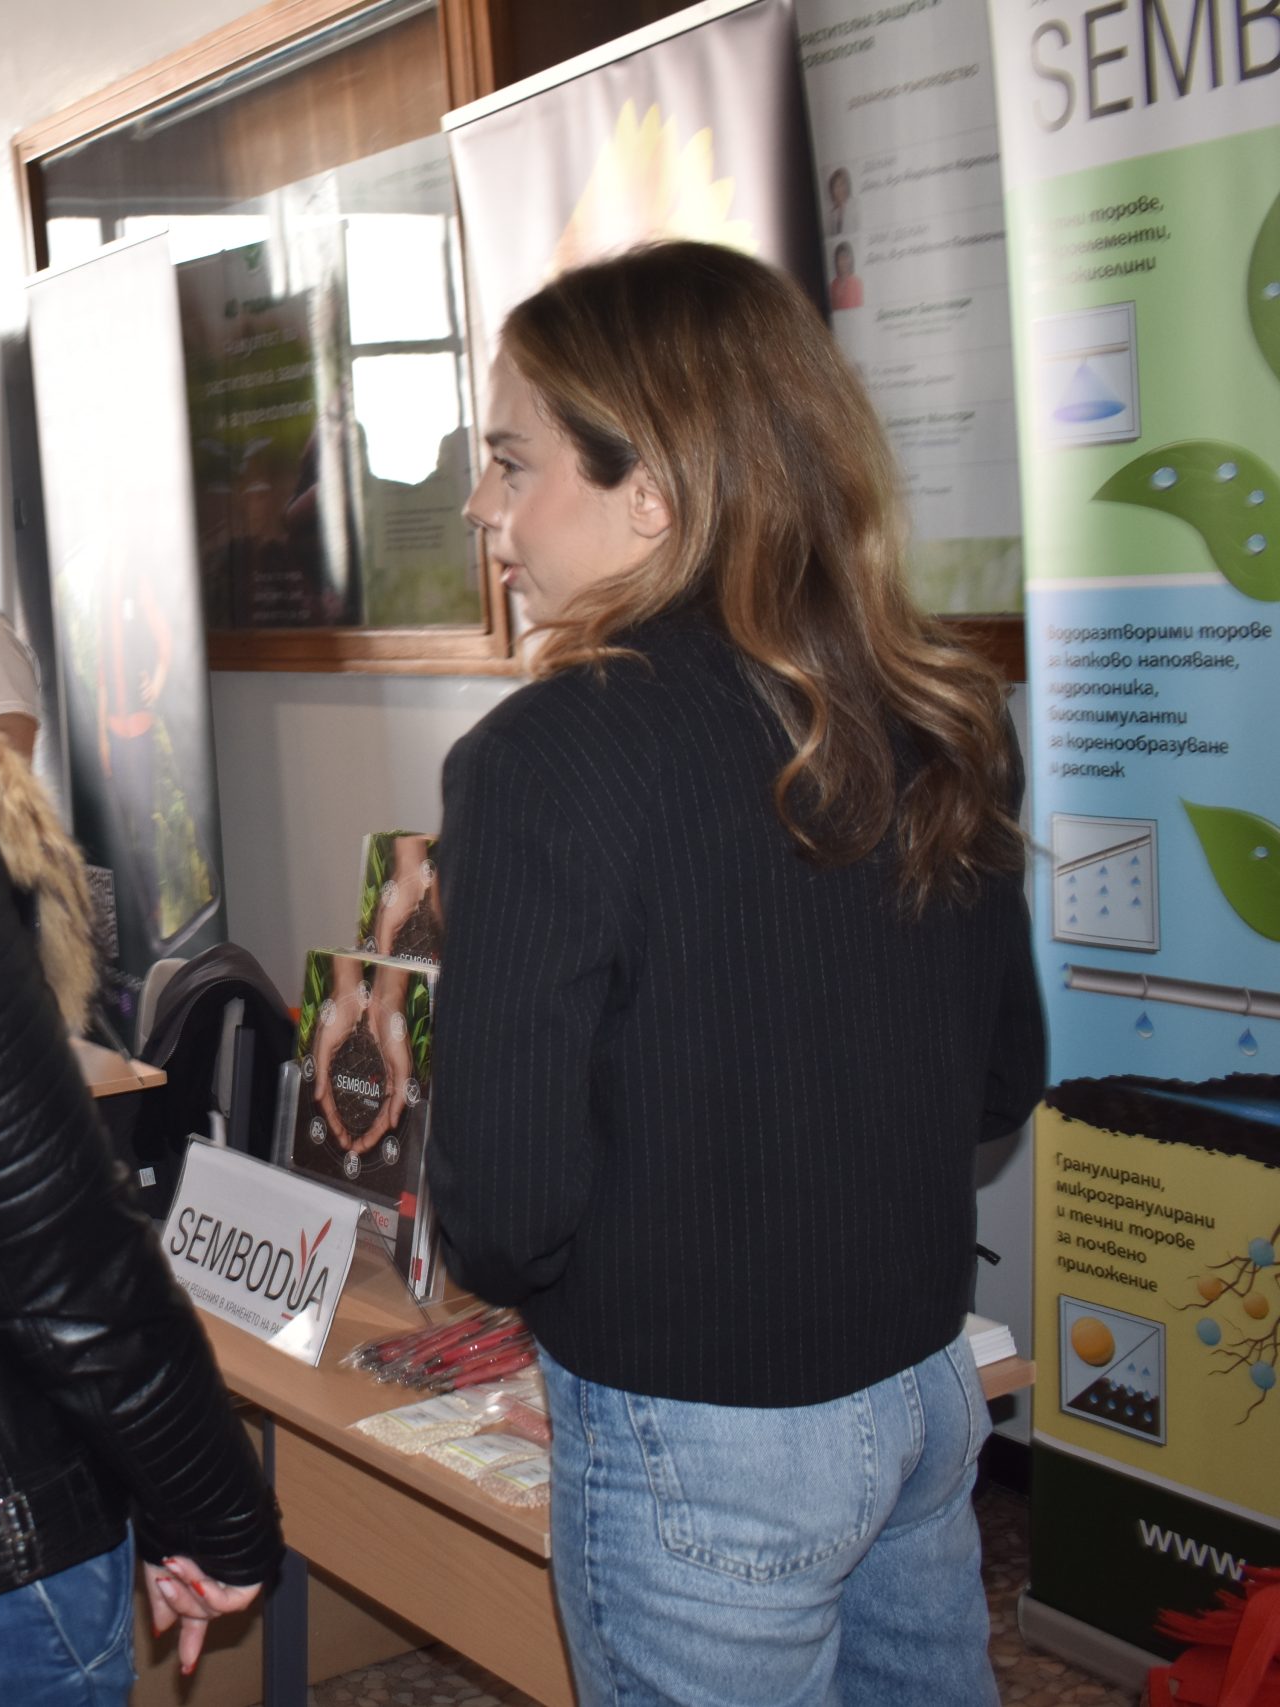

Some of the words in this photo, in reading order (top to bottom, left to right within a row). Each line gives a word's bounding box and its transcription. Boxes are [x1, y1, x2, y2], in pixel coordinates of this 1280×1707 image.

[1030, 0, 1280, 133] SEMB
[1089, 194, 1165, 221] торове,
[1199, 621, 1272, 641] торове
[1064, 651, 1133, 668] капково
[1138, 652, 1240, 670] напояване,
[1049, 678, 1159, 699] хидропоника,
[1048, 704, 1188, 728] биостимуланти
[1066, 732, 1229, 757] коренообразуване
[1062, 761, 1126, 778] растеж
[336, 1074, 380, 1098] SEMBODJA
[1056, 1152, 1166, 1192] Гранулирани,
[1056, 1180, 1216, 1229] микрогранулирани
[1056, 1205, 1066, 1218] и
[1070, 1208, 1124, 1233] течни
[1128, 1222, 1196, 1251] торове
[1056, 1229, 1071, 1245] за
[1076, 1236, 1148, 1265] почвено
[1057, 1255, 1159, 1293] приложение
[190, 1282, 220, 1305] РЕШЕНИЯ
[260, 1320, 271, 1331] НА
